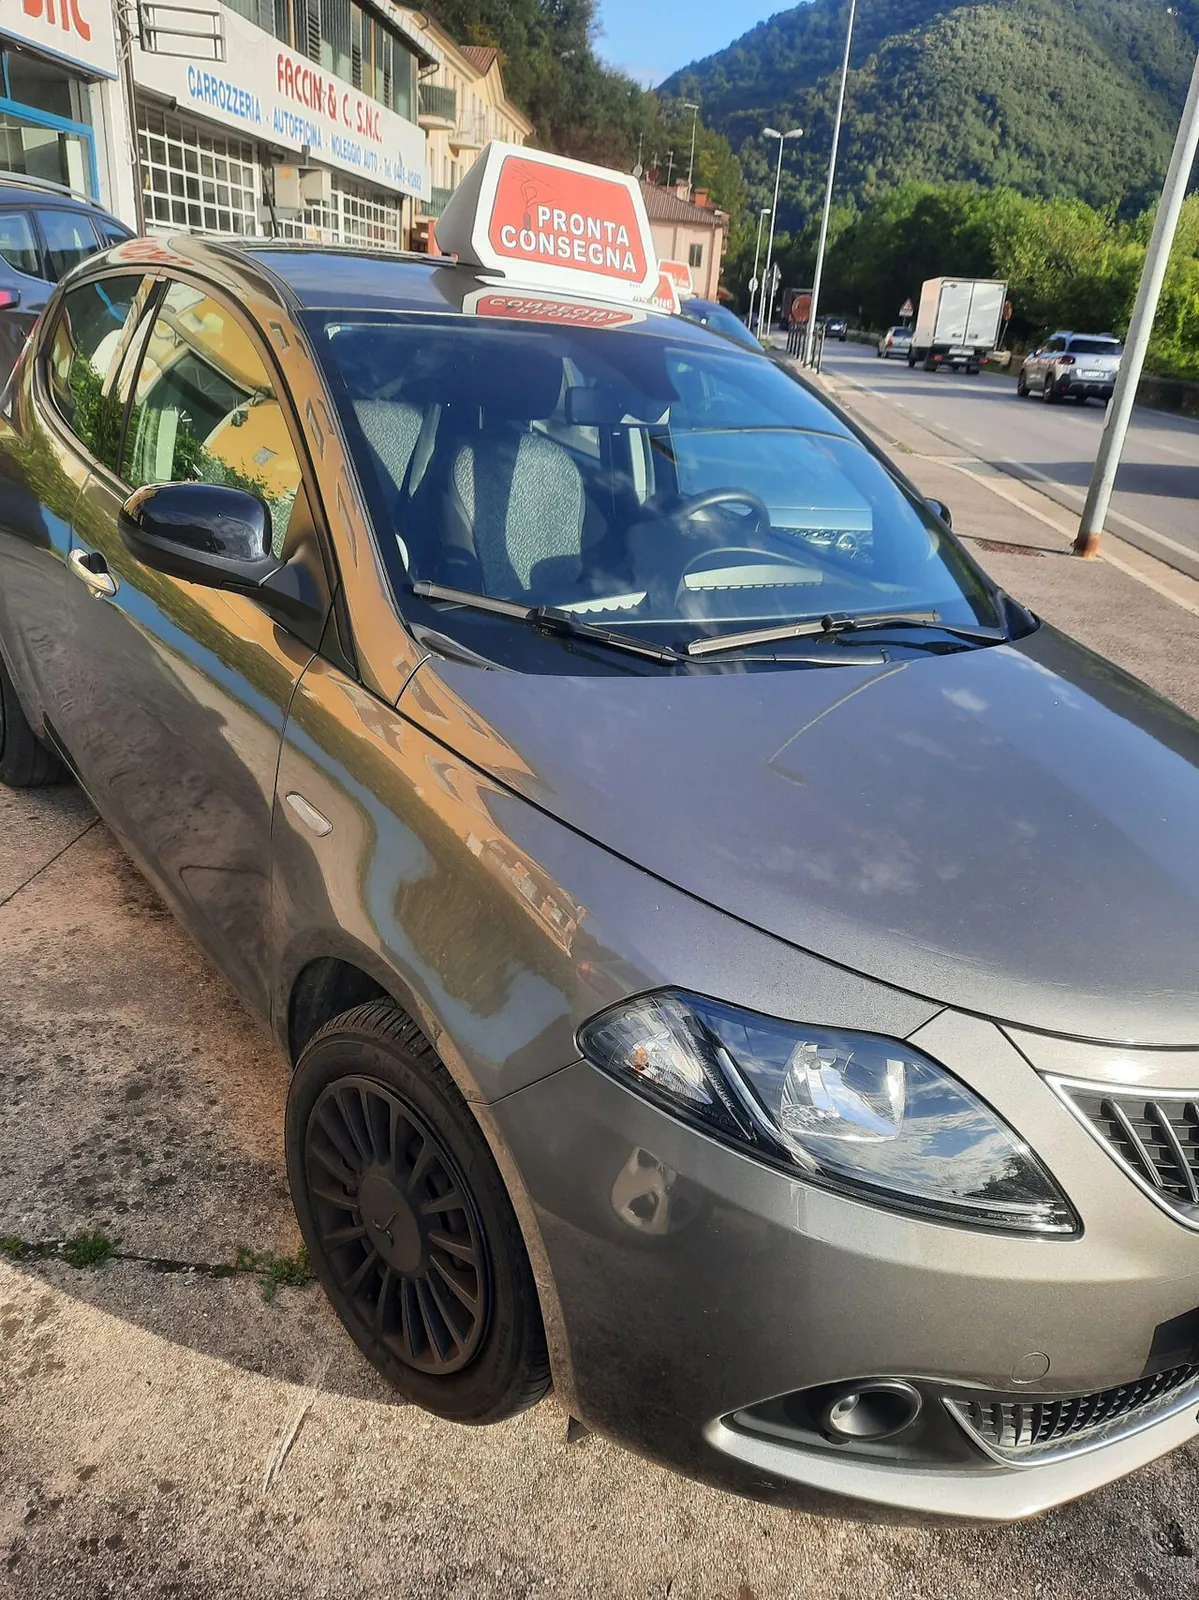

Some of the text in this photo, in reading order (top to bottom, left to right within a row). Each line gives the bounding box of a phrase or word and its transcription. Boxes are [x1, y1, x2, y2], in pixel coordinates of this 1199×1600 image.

[187, 64, 262, 125] CARROZZERIA
[272, 107, 323, 149] AUTOFFICINA
[327, 83, 338, 121] &
[342, 93, 353, 129] C.
[500, 224, 637, 274] CONSEGNA
[536, 203, 630, 247] PRONTA
